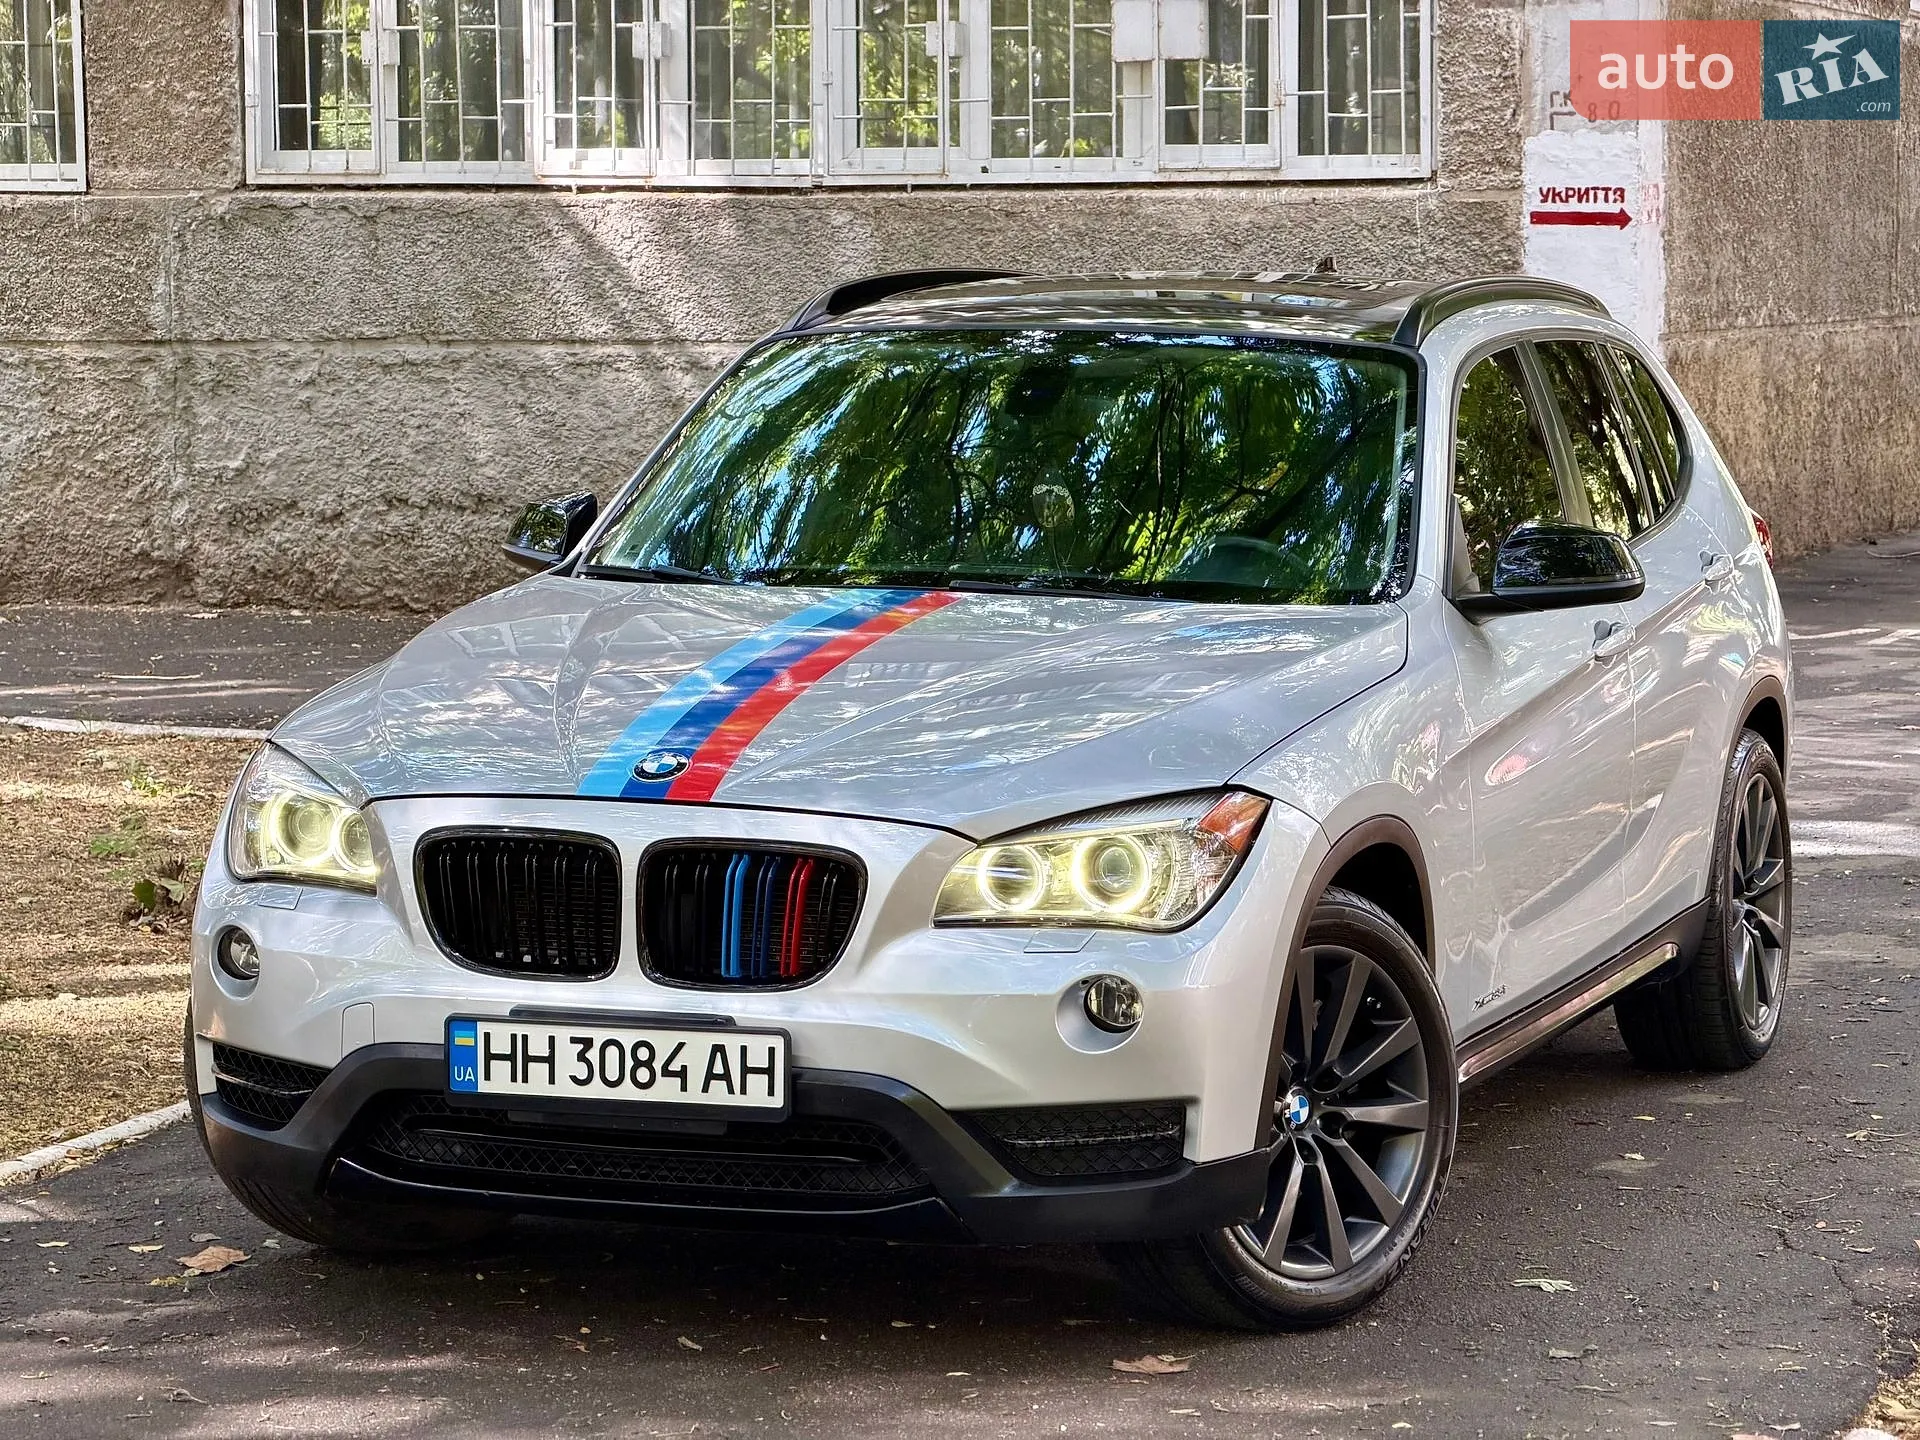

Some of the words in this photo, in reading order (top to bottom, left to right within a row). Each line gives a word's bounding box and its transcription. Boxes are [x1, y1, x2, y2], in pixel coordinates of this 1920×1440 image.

[1539, 186, 1626, 204] УКРИТТЯ
[483, 1031, 556, 1086] HH
[568, 1036, 688, 1093] 3084
[701, 1043, 776, 1098] AH
[454, 1066, 476, 1083] UA
